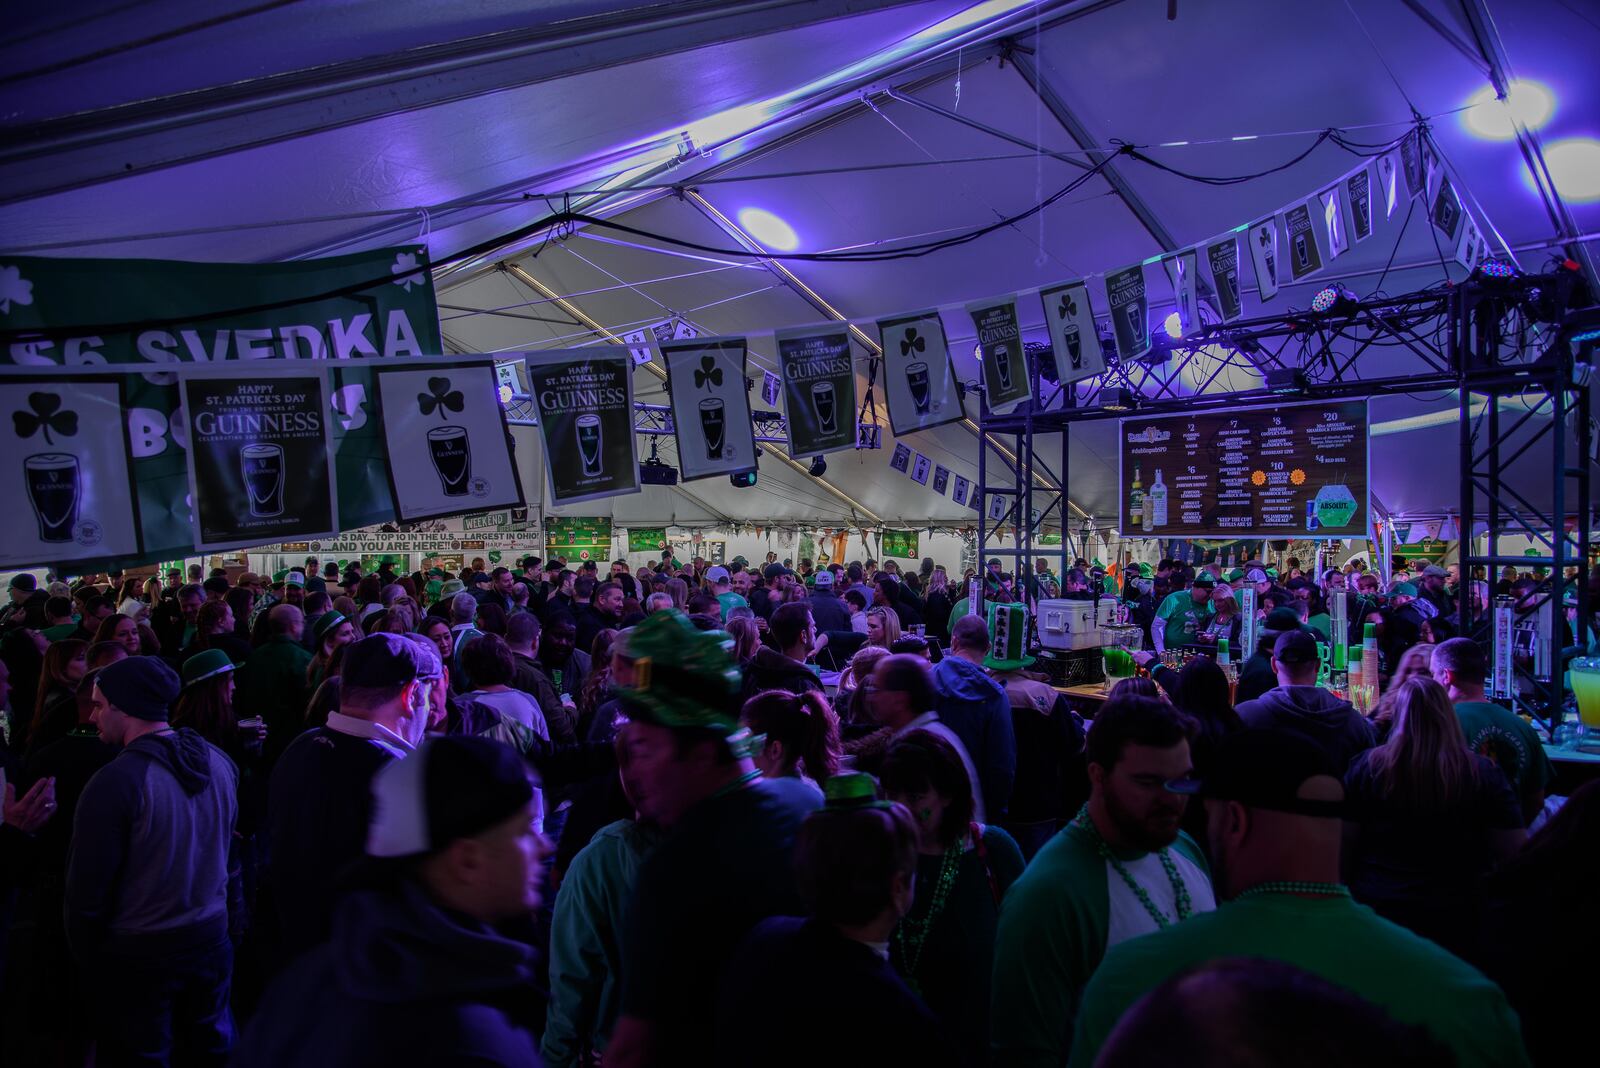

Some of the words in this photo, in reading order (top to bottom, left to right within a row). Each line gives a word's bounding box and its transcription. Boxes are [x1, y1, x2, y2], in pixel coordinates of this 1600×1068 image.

[1110, 282, 1145, 306] GUINNESS
[980, 324, 1018, 344] GUINNESS
[806, 340, 824, 348] HAPPY
[800, 348, 829, 356] PATRICK'S
[568, 366, 594, 375] HAPPY
[786, 358, 850, 379] GUINNESS
[545, 378, 558, 386] ST.
[560, 374, 598, 384] PATRICK'S
[599, 372, 616, 381] DAY
[238, 385, 274, 394] HAPPY
[206, 396, 223, 406] ST.
[226, 394, 281, 404] PATRICK'S
[284, 394, 306, 404] DAY
[540, 387, 625, 410] GUINNESS
[1273, 416, 1280, 425] $8
[1322, 412, 1338, 421] $20
[195, 412, 320, 435] GUINNESS
[1188, 424, 1194, 432] $2
[1230, 420, 1238, 428] $7
[1188, 466, 1196, 474] $6
[1270, 462, 1284, 470] $10
[466, 514, 502, 530] WEEKEND
[360, 542, 384, 551] YOU
[386, 542, 410, 550] ARE
[413, 541, 450, 550] HERE!!
[1064, 622, 1069, 633] 2
